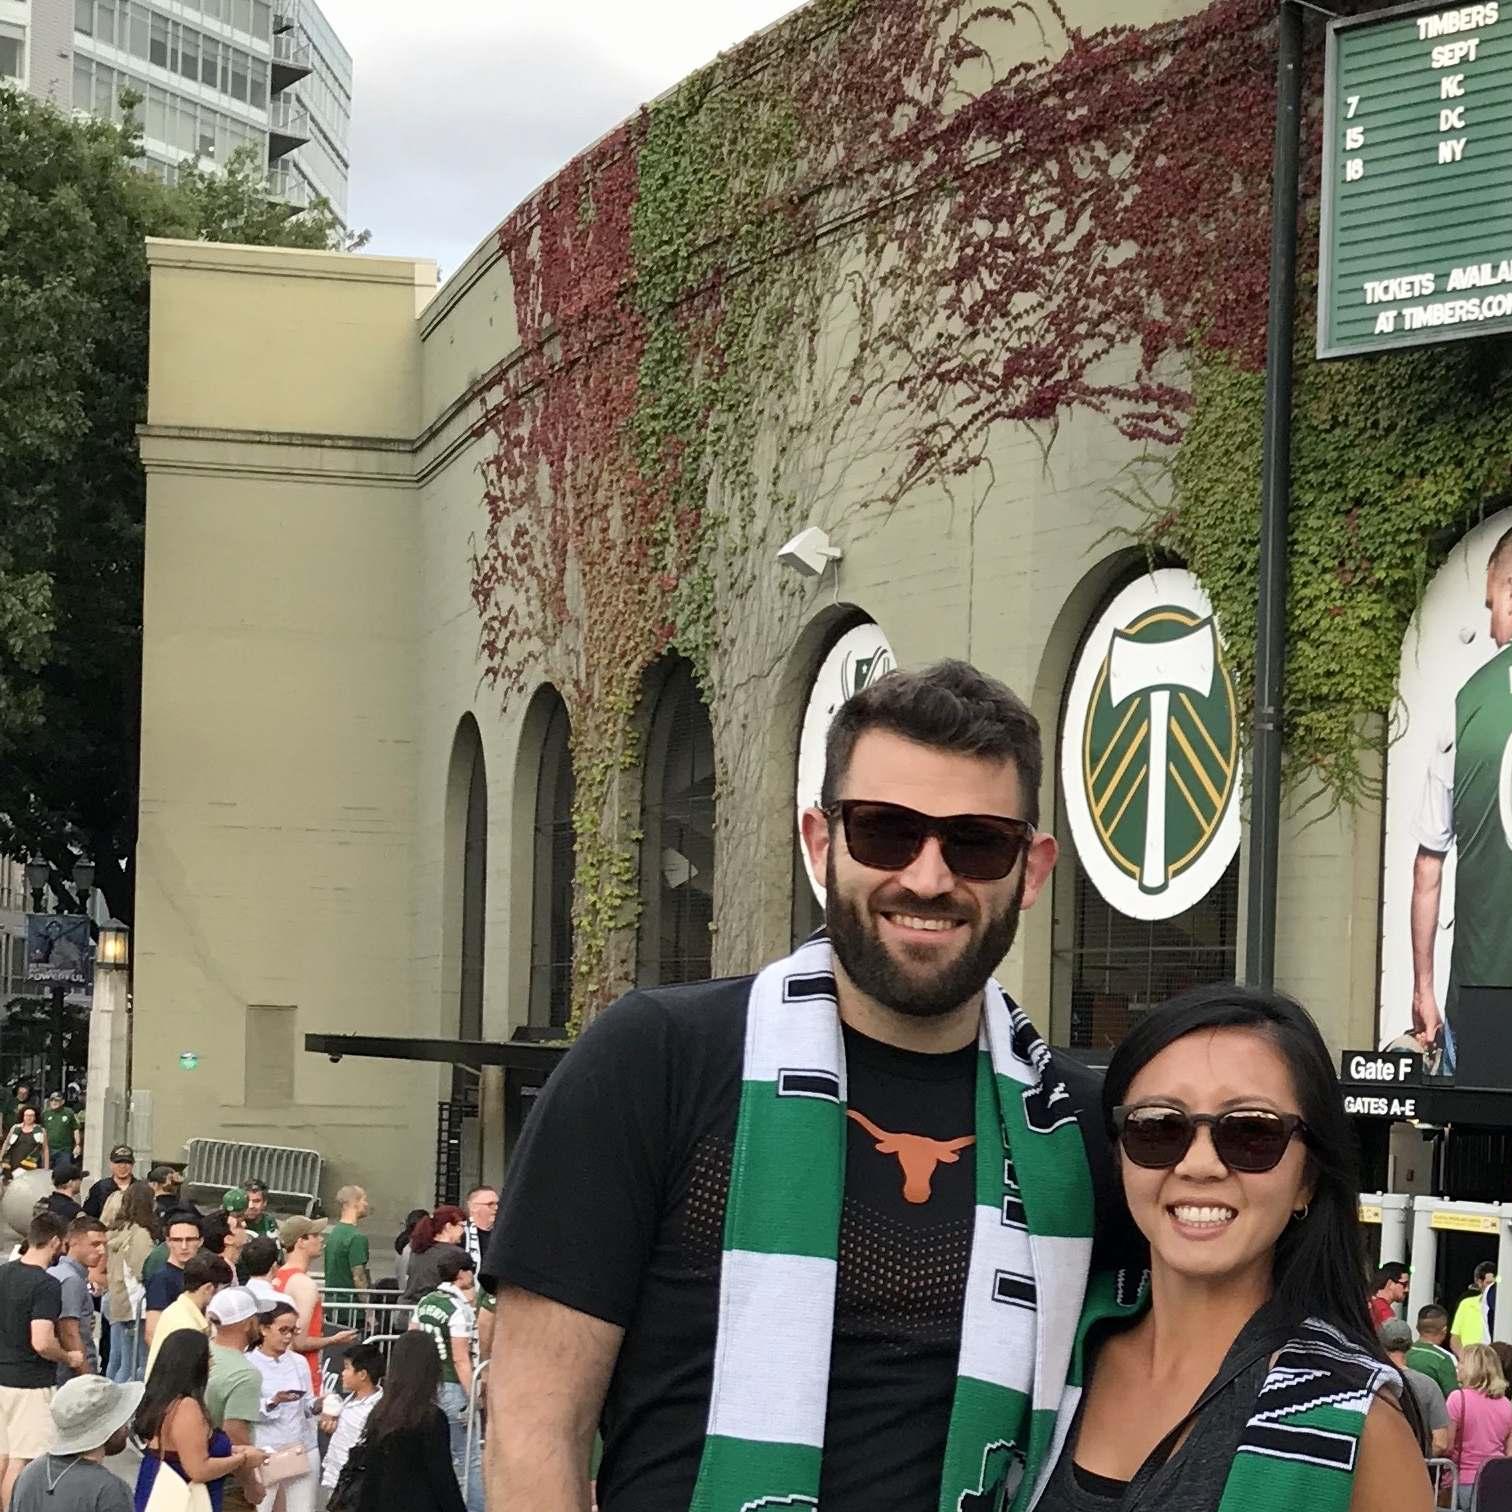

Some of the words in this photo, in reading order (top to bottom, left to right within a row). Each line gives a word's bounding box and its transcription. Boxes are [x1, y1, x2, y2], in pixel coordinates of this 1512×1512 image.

[1417, 2, 1498, 40] TIMBERS
[1431, 38, 1479, 69] SEPT
[1346, 95, 1360, 118] 7
[1440, 74, 1465, 99] KC
[1345, 126, 1365, 150] 15
[1439, 106, 1466, 131] DC
[1345, 158, 1364, 182] 18
[1438, 137, 1467, 164] NY
[1363, 273, 1435, 304] TICKETS
[1374, 310, 1398, 334] AT
[1350, 1056, 1395, 1080] Gate
[1399, 1058, 1412, 1080] F
[1344, 1096, 1388, 1115] GATES
[1390, 1099, 1415, 1115] A-E
